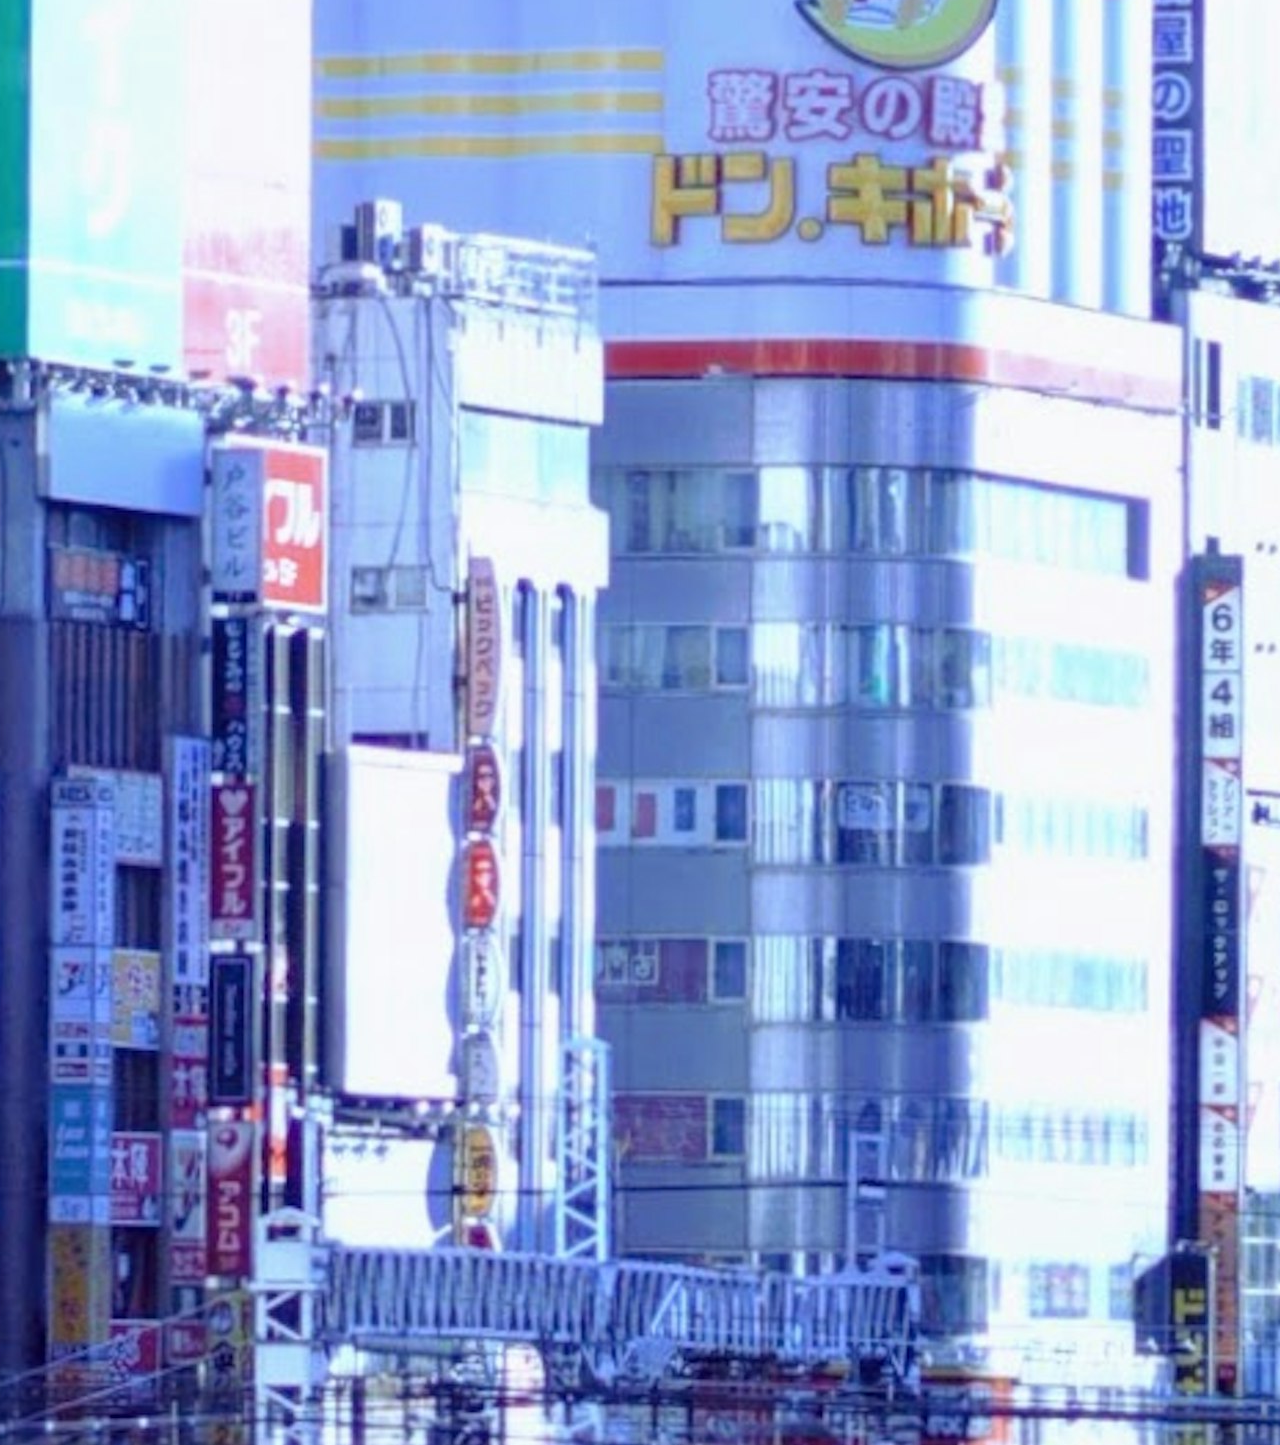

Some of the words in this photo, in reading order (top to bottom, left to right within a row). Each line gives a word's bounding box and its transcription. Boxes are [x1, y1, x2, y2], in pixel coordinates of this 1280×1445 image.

[1208, 604, 1235, 740] 6年4組
[221, 816, 247, 916] アイフル
